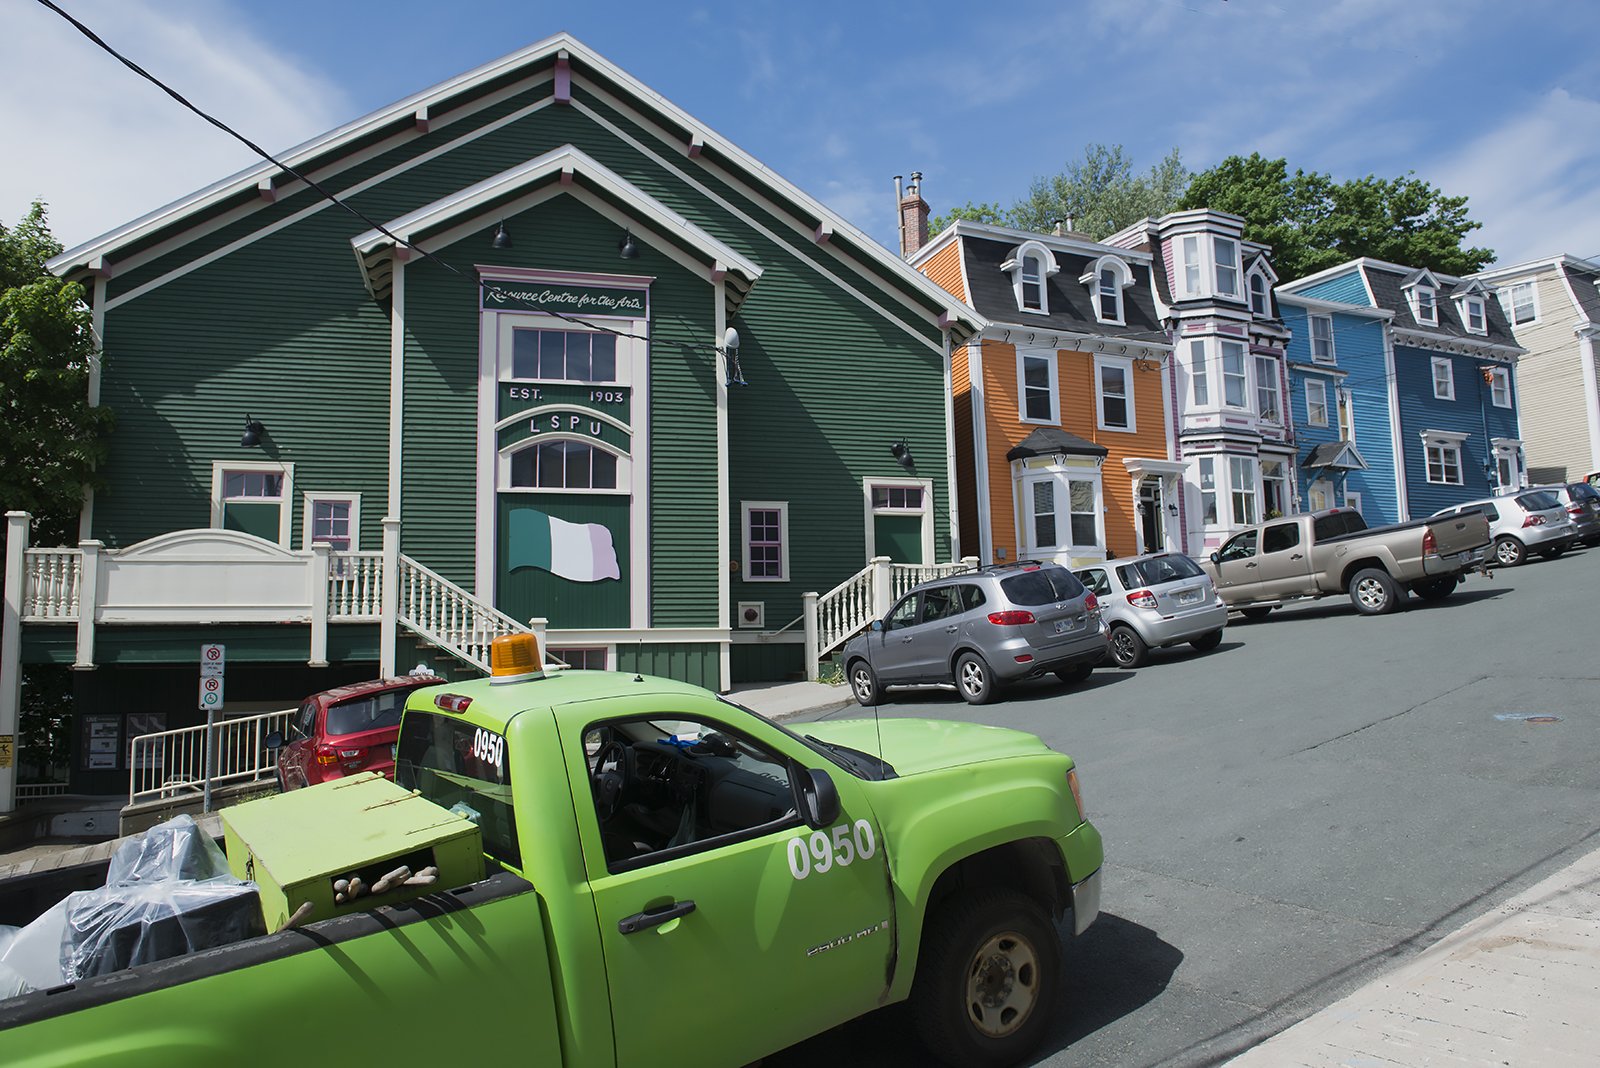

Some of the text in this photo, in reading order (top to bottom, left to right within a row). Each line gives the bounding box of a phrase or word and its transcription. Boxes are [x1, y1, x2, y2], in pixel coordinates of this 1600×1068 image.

[538, 290, 579, 304] Centre
[577, 293, 597, 308] for
[597, 294, 615, 306] the
[611, 296, 644, 310] Arts
[509, 387, 624, 403] EST. 1903
[473, 727, 504, 768] 0950
[787, 818, 876, 881] 0950
[806, 924, 878, 957] 2500 HD
